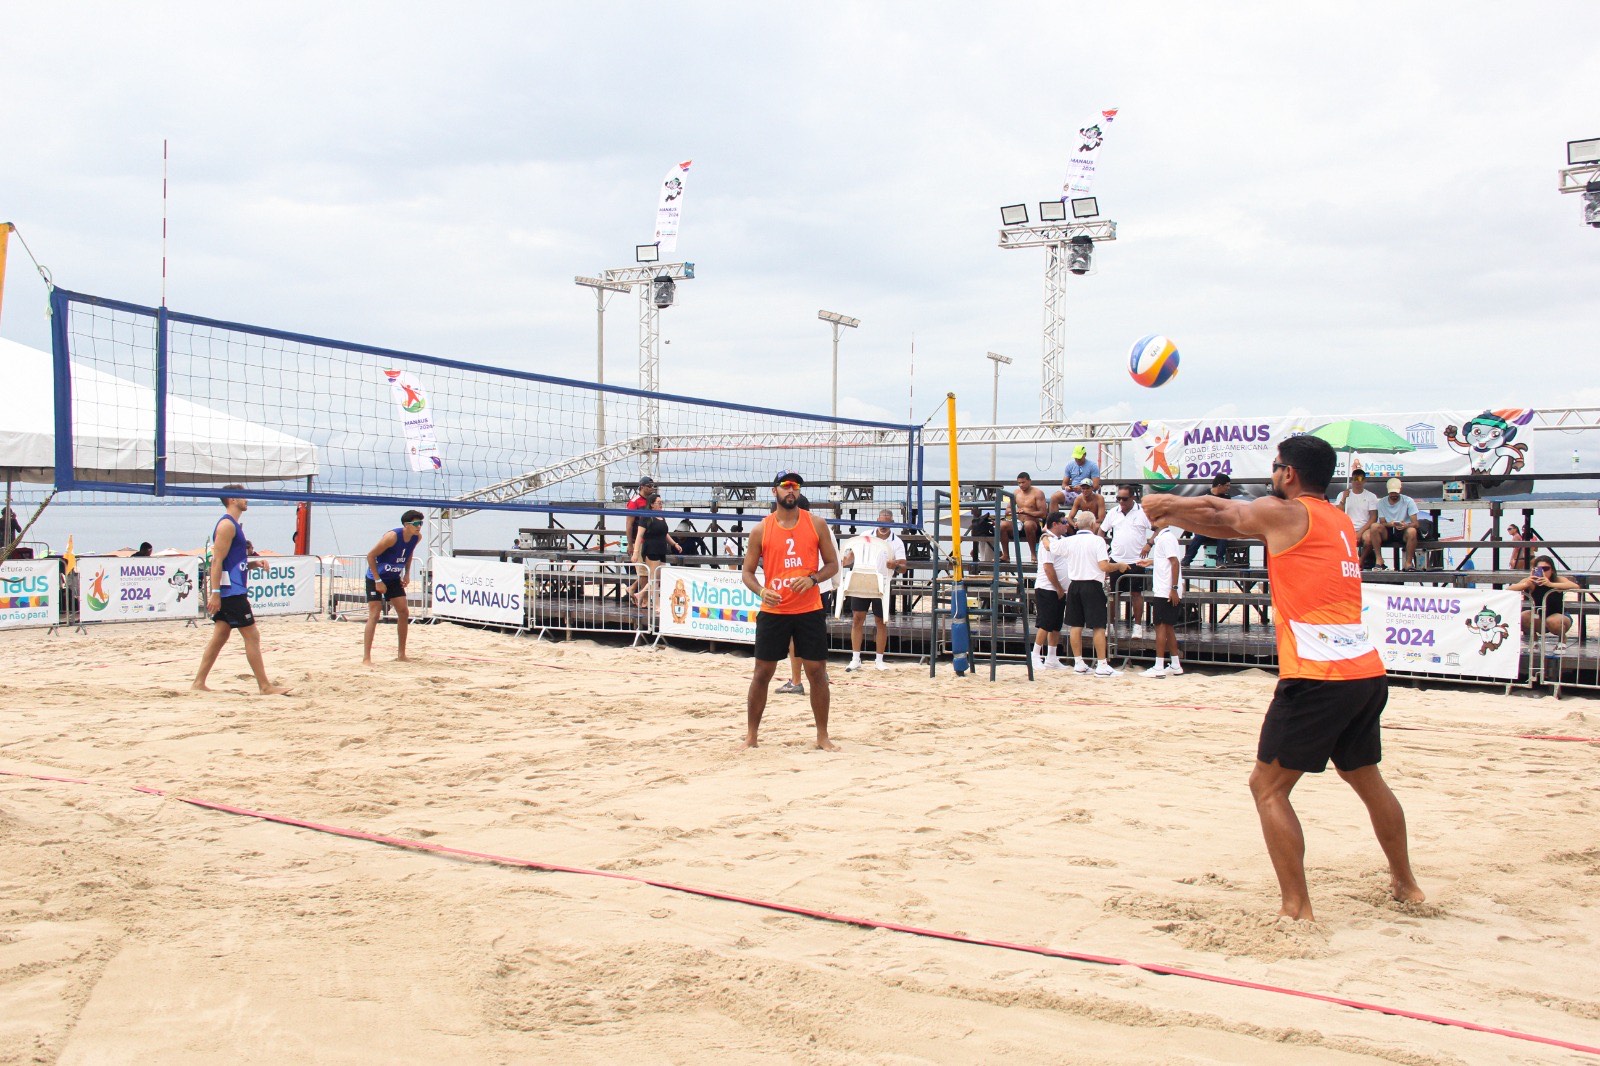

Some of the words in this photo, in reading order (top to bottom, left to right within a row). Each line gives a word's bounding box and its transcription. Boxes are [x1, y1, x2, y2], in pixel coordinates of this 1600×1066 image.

[1184, 425, 1270, 446] MANAUS
[1406, 431, 1435, 444] UNESCO
[1186, 460, 1233, 478] 2024
[1365, 463, 1404, 471] Manaus
[786, 538, 796, 556] 2
[1340, 530, 1352, 557] 1
[784, 557, 802, 568] BRA
[1341, 560, 1360, 578] BRA
[120, 566, 165, 576] MANAUS
[248, 566, 295, 580] anaus
[486, 578, 494, 587] DE
[120, 588, 151, 600] 2024
[247, 582, 295, 602] sporte
[461, 589, 520, 610] MANAUS
[1387, 596, 1460, 614] MANAUS
[9, 611, 26, 620] não
[28, 610, 48, 620] para!
[699, 622, 729, 632] trabalho
[731, 624, 744, 633] não
[1385, 626, 1435, 646] 2024
